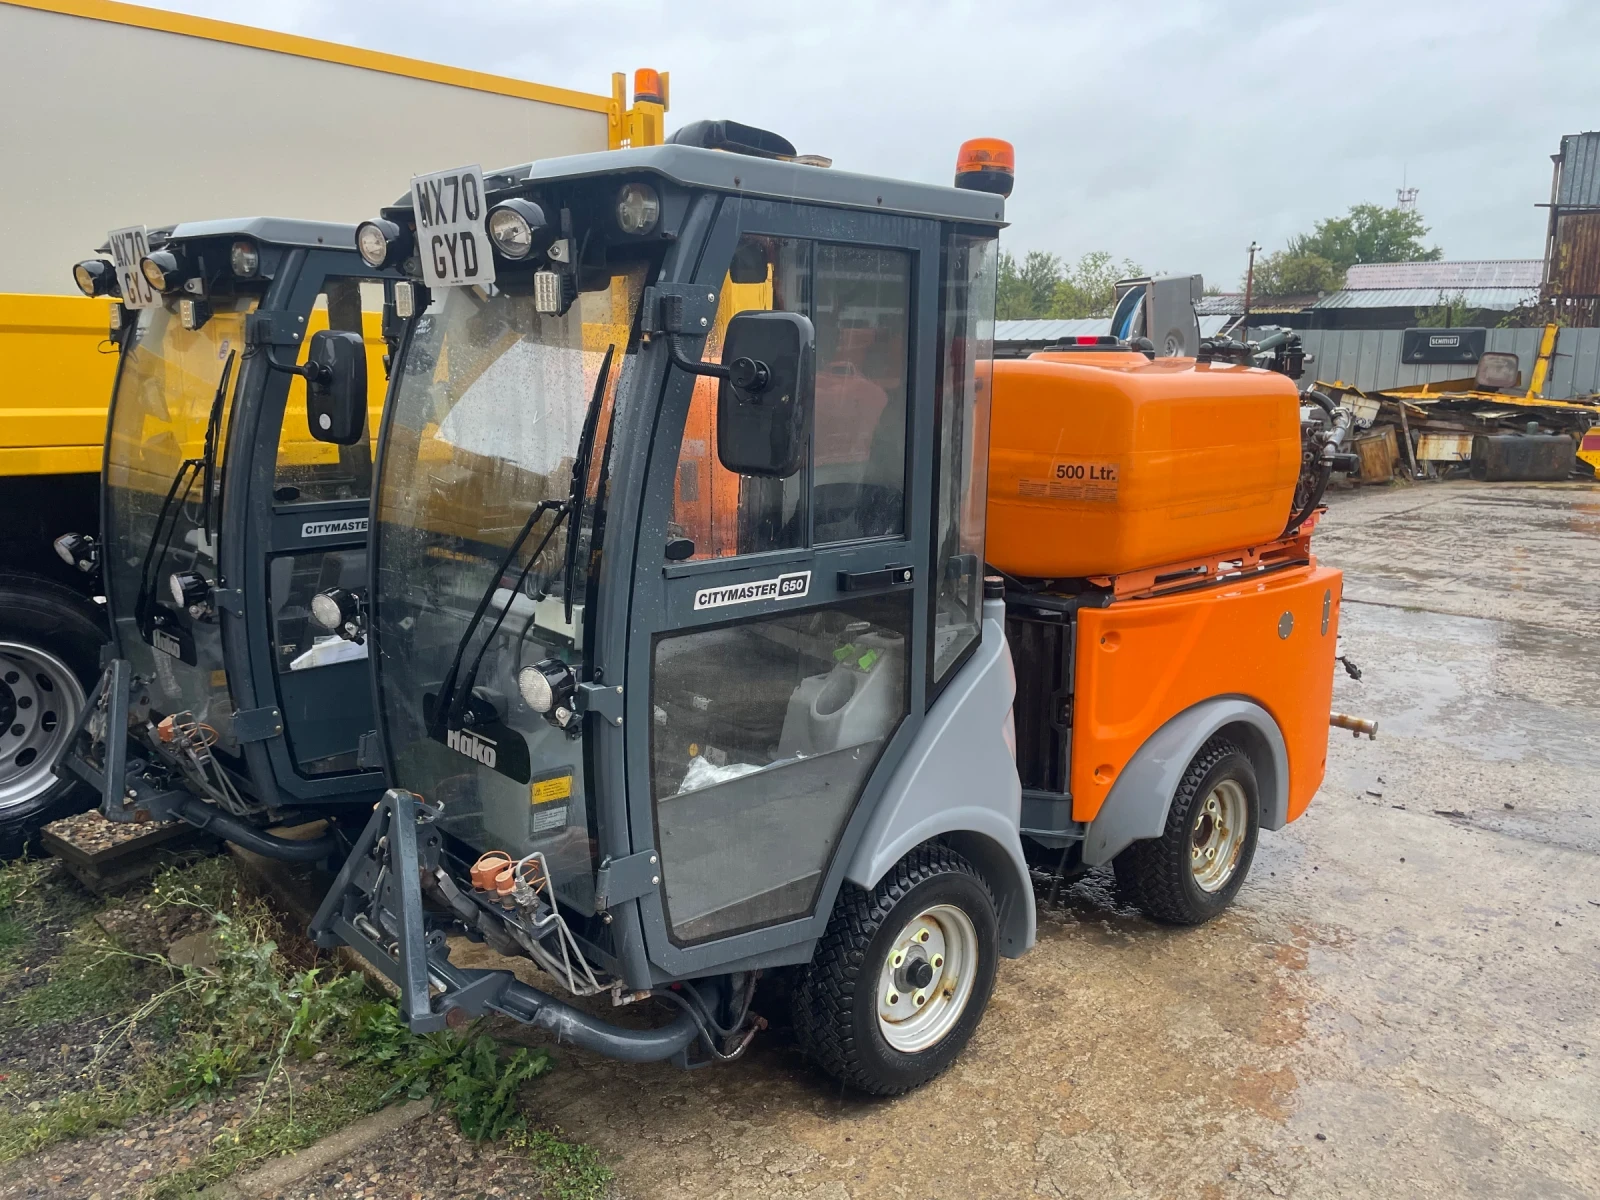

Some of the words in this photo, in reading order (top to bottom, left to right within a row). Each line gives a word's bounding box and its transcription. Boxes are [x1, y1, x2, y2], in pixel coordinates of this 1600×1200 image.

[416, 173, 480, 227] WX70
[431, 231, 479, 279] GYD
[1056, 465, 1085, 479] 500
[1089, 465, 1116, 480] Ltr.
[698, 583, 778, 605] CITYMASTER
[782, 579, 804, 593] 650
[447, 729, 497, 769] Hako
